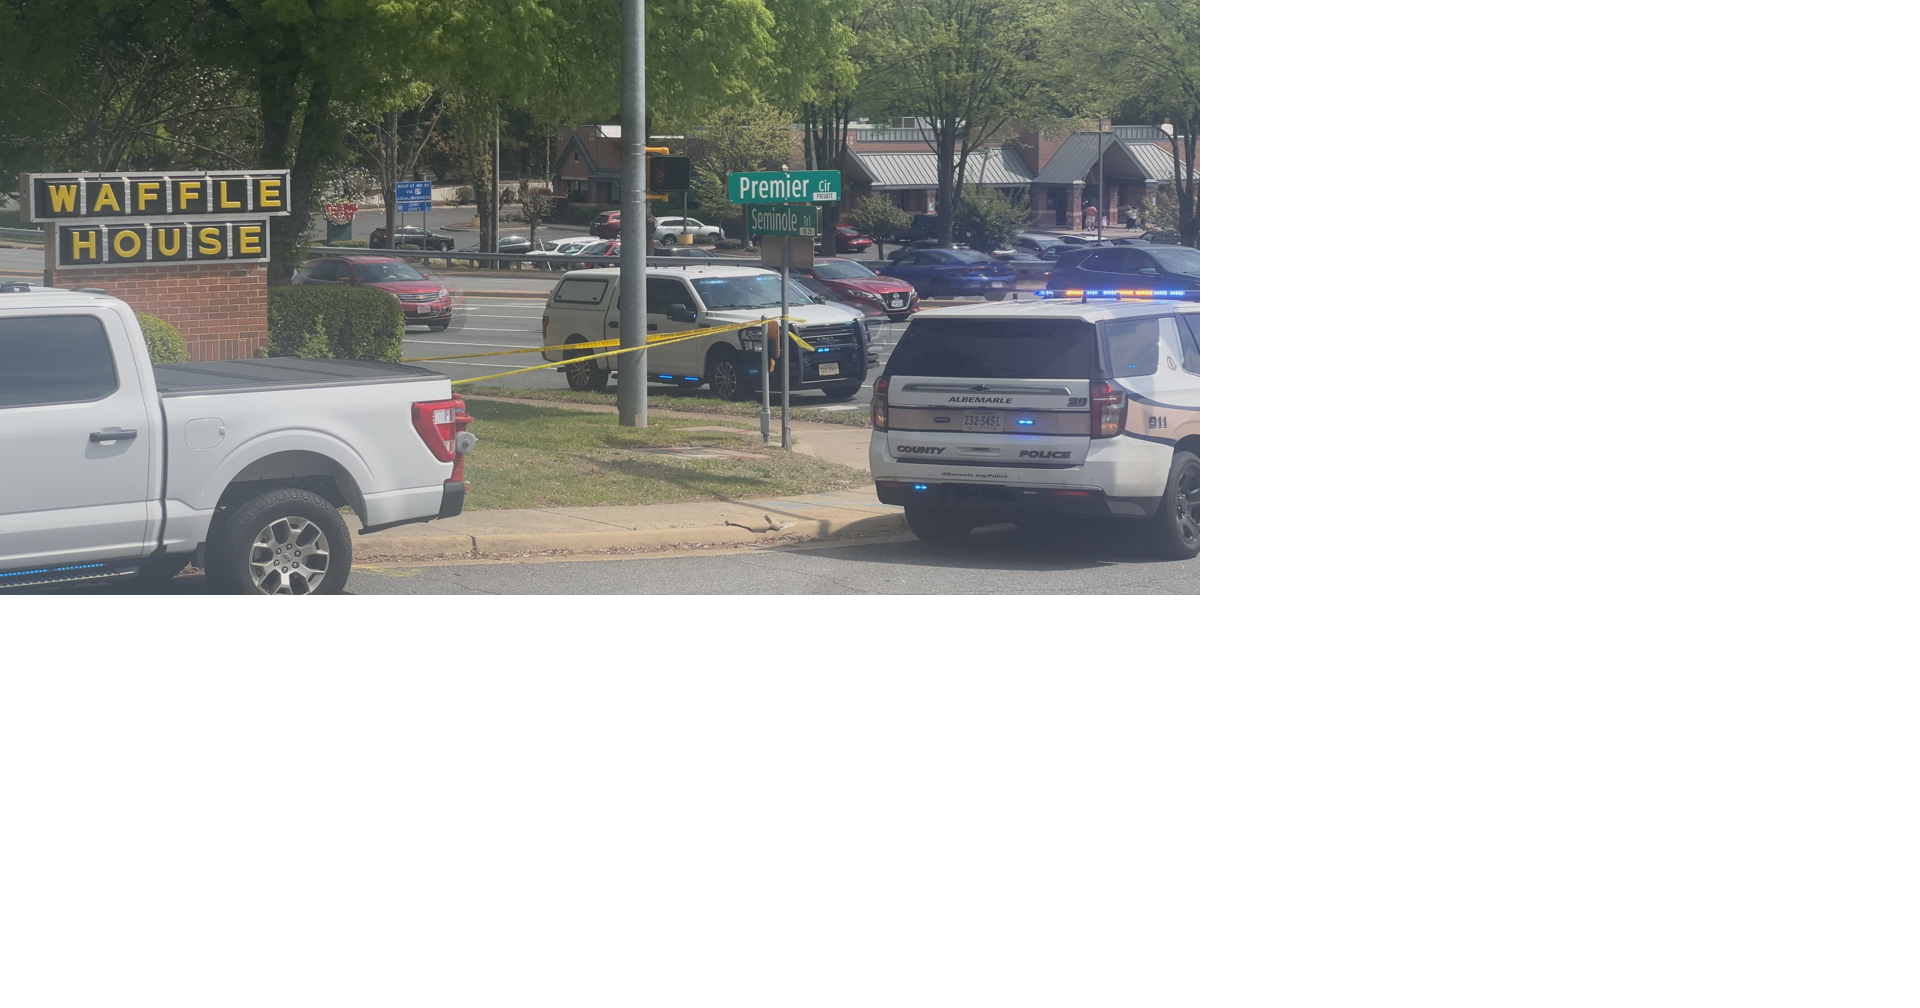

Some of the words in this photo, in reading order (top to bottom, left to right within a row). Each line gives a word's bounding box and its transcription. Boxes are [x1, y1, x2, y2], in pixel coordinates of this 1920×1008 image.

[740, 174, 810, 199] Premier
[818, 179, 831, 192] Cir
[48, 180, 281, 213] WAFFLE
[751, 207, 798, 232] Seminole
[803, 215, 811, 227] Trl
[72, 226, 262, 260] HOUSE
[948, 396, 1013, 404] ALBEMARLE
[1067, 397, 1088, 407] 39
[1148, 415, 1168, 429] 911
[896, 445, 947, 455] COUNTY
[1019, 450, 1072, 459] POLICE
